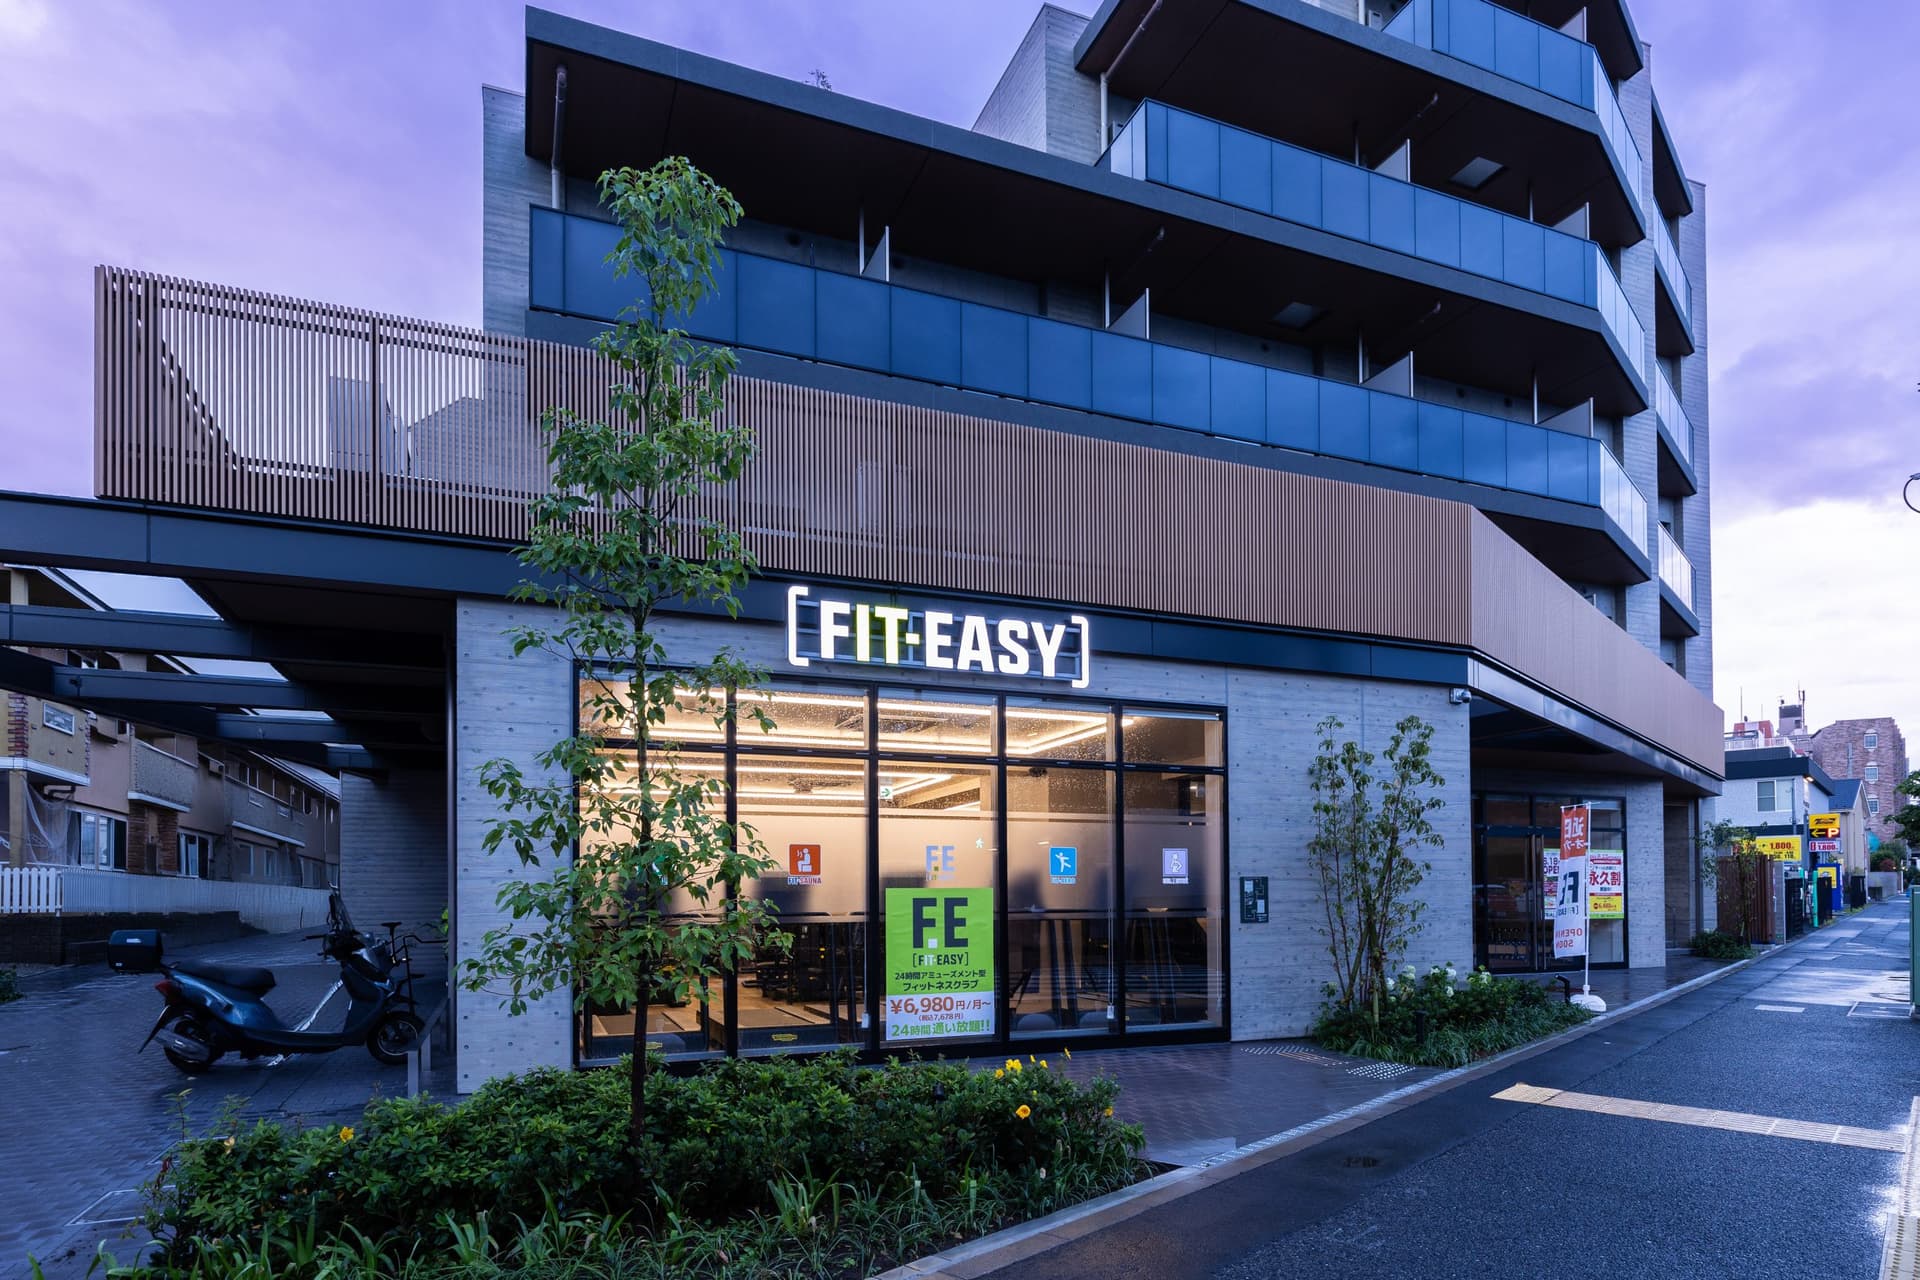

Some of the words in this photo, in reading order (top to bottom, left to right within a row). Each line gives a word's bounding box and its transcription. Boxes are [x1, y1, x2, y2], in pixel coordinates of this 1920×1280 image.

[1828, 828, 1840, 838] P
[1589, 871, 1621, 886] 永久割
[895, 969, 987, 981] 24時間アミューズメント型
[903, 980, 979, 992] フィットネスクラブ
